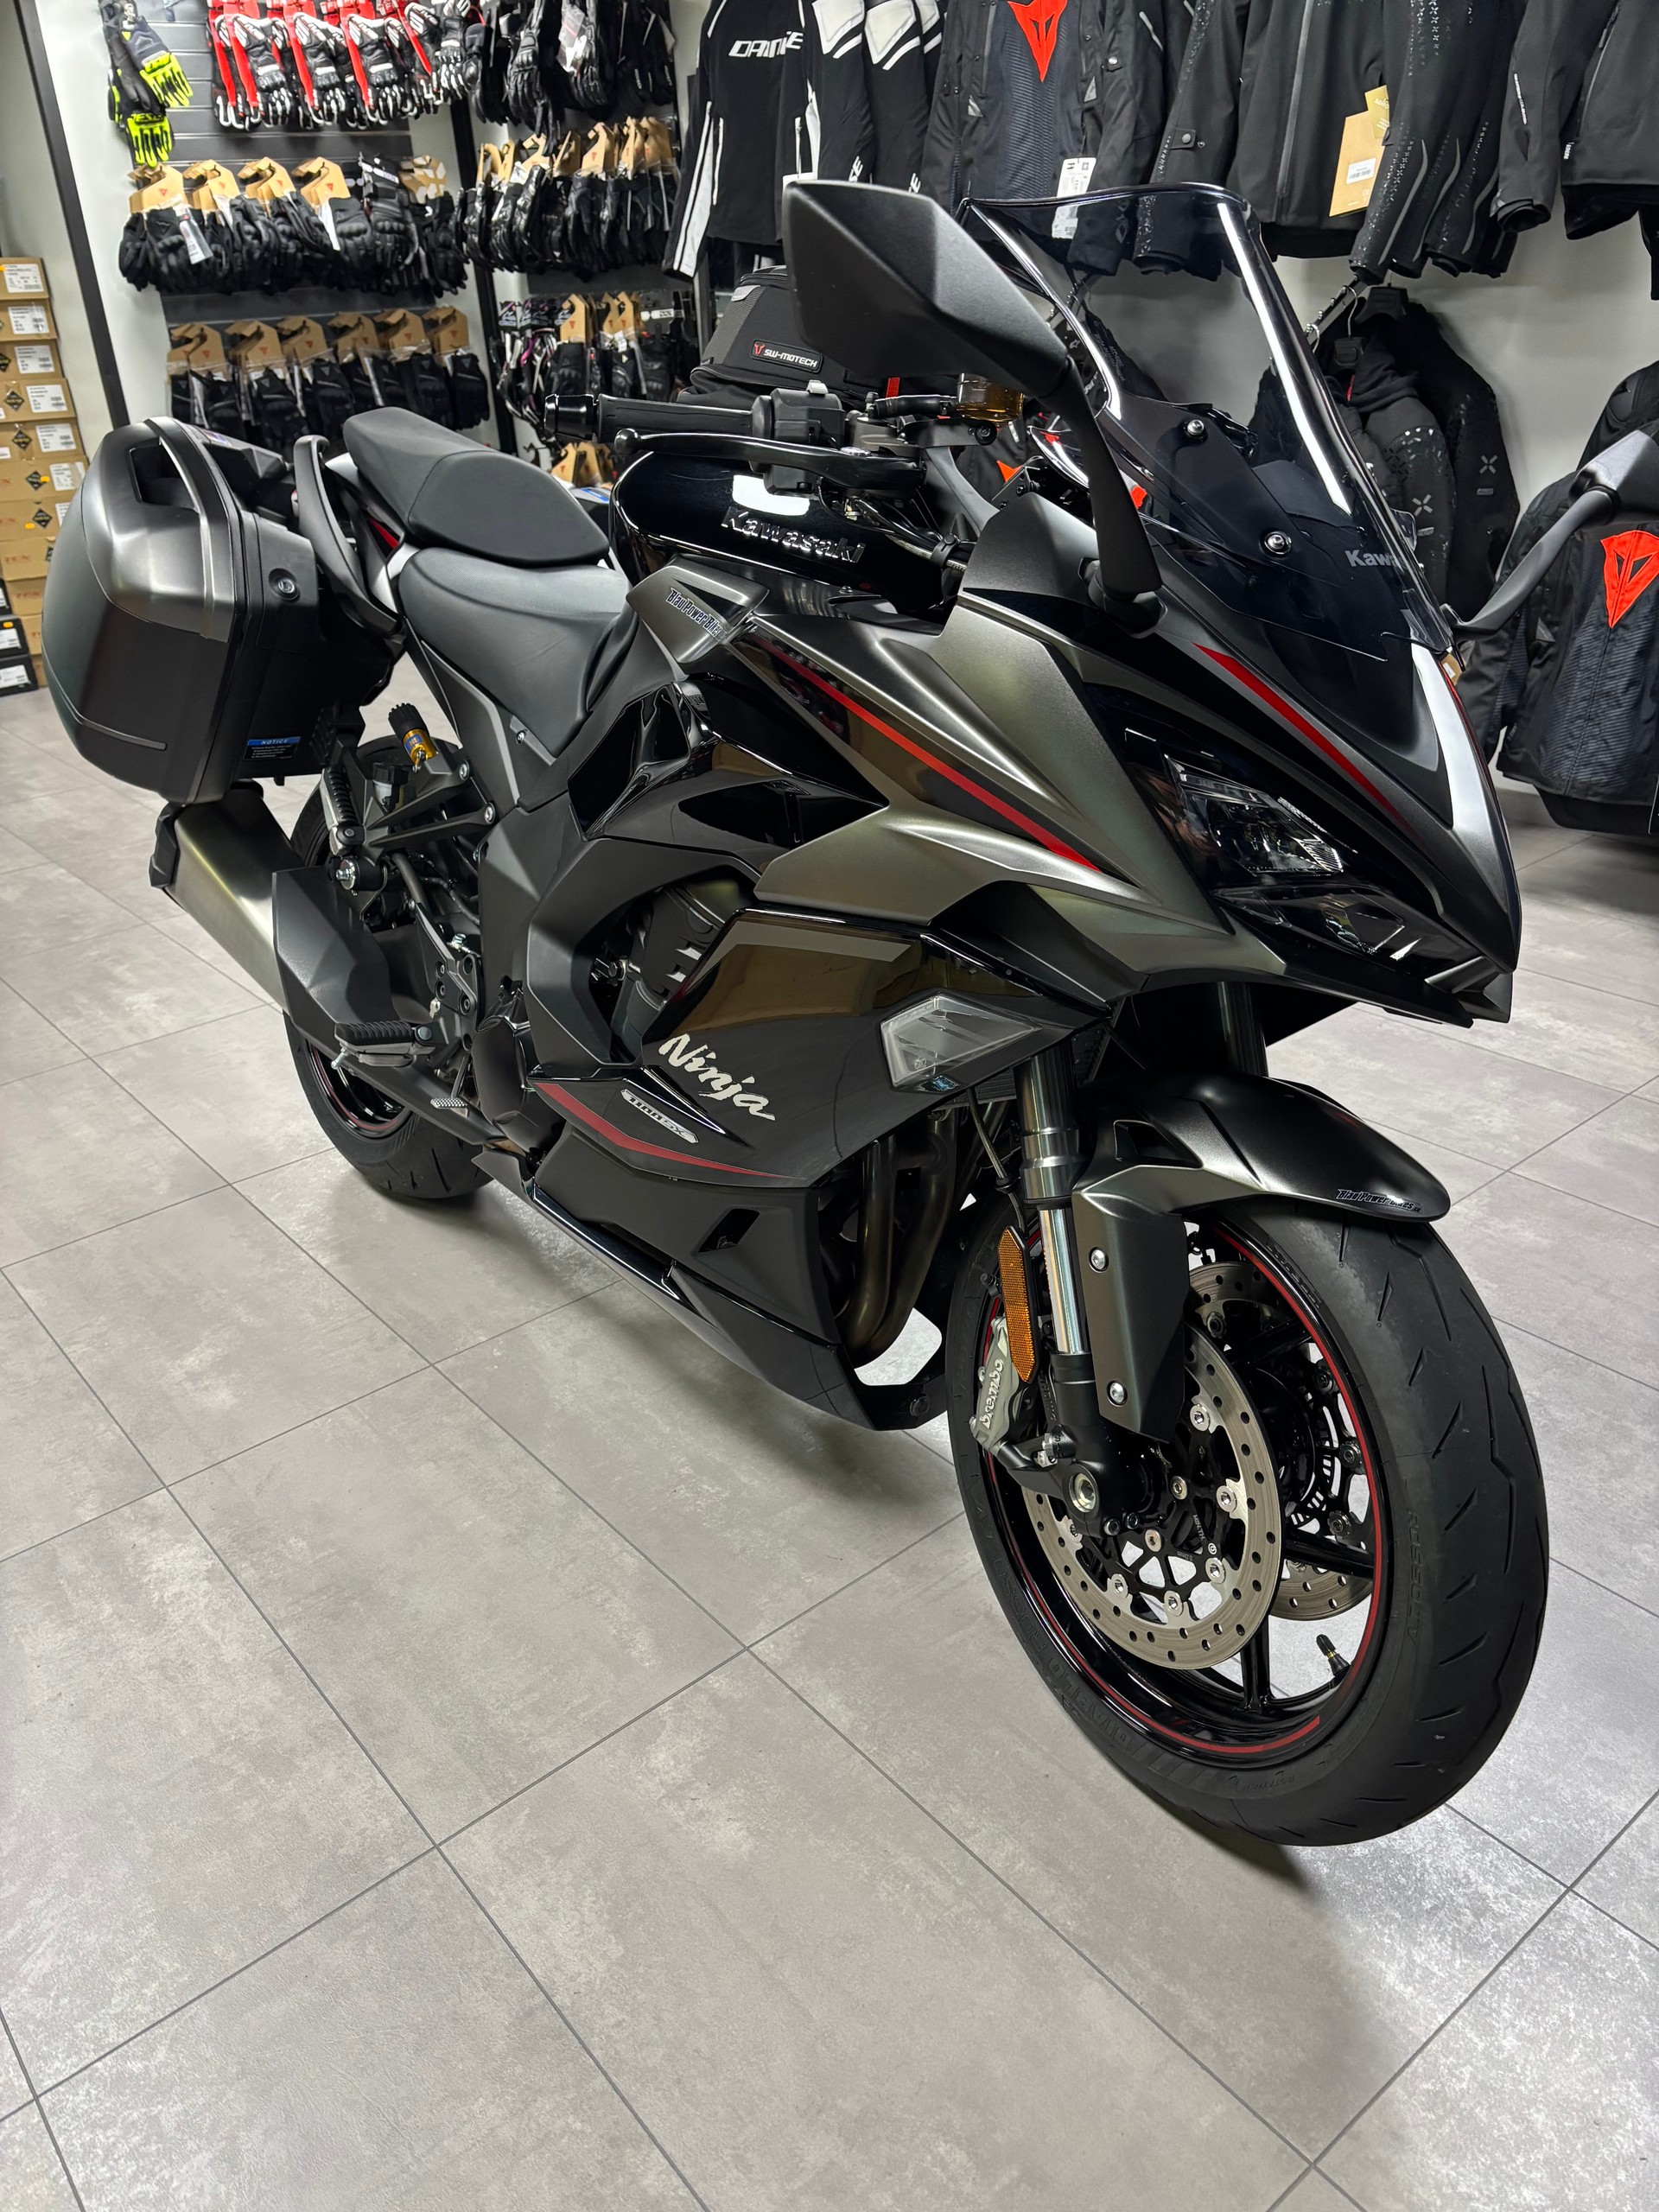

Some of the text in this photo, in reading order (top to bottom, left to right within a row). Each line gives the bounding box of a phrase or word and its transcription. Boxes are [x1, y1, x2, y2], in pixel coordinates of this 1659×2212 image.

[763, 348, 818, 368] SW-MOTECH
[721, 506, 866, 563] Kawasaki
[658, 1033, 776, 1122] Ninja
[979, 1358, 1005, 1430] brembo
